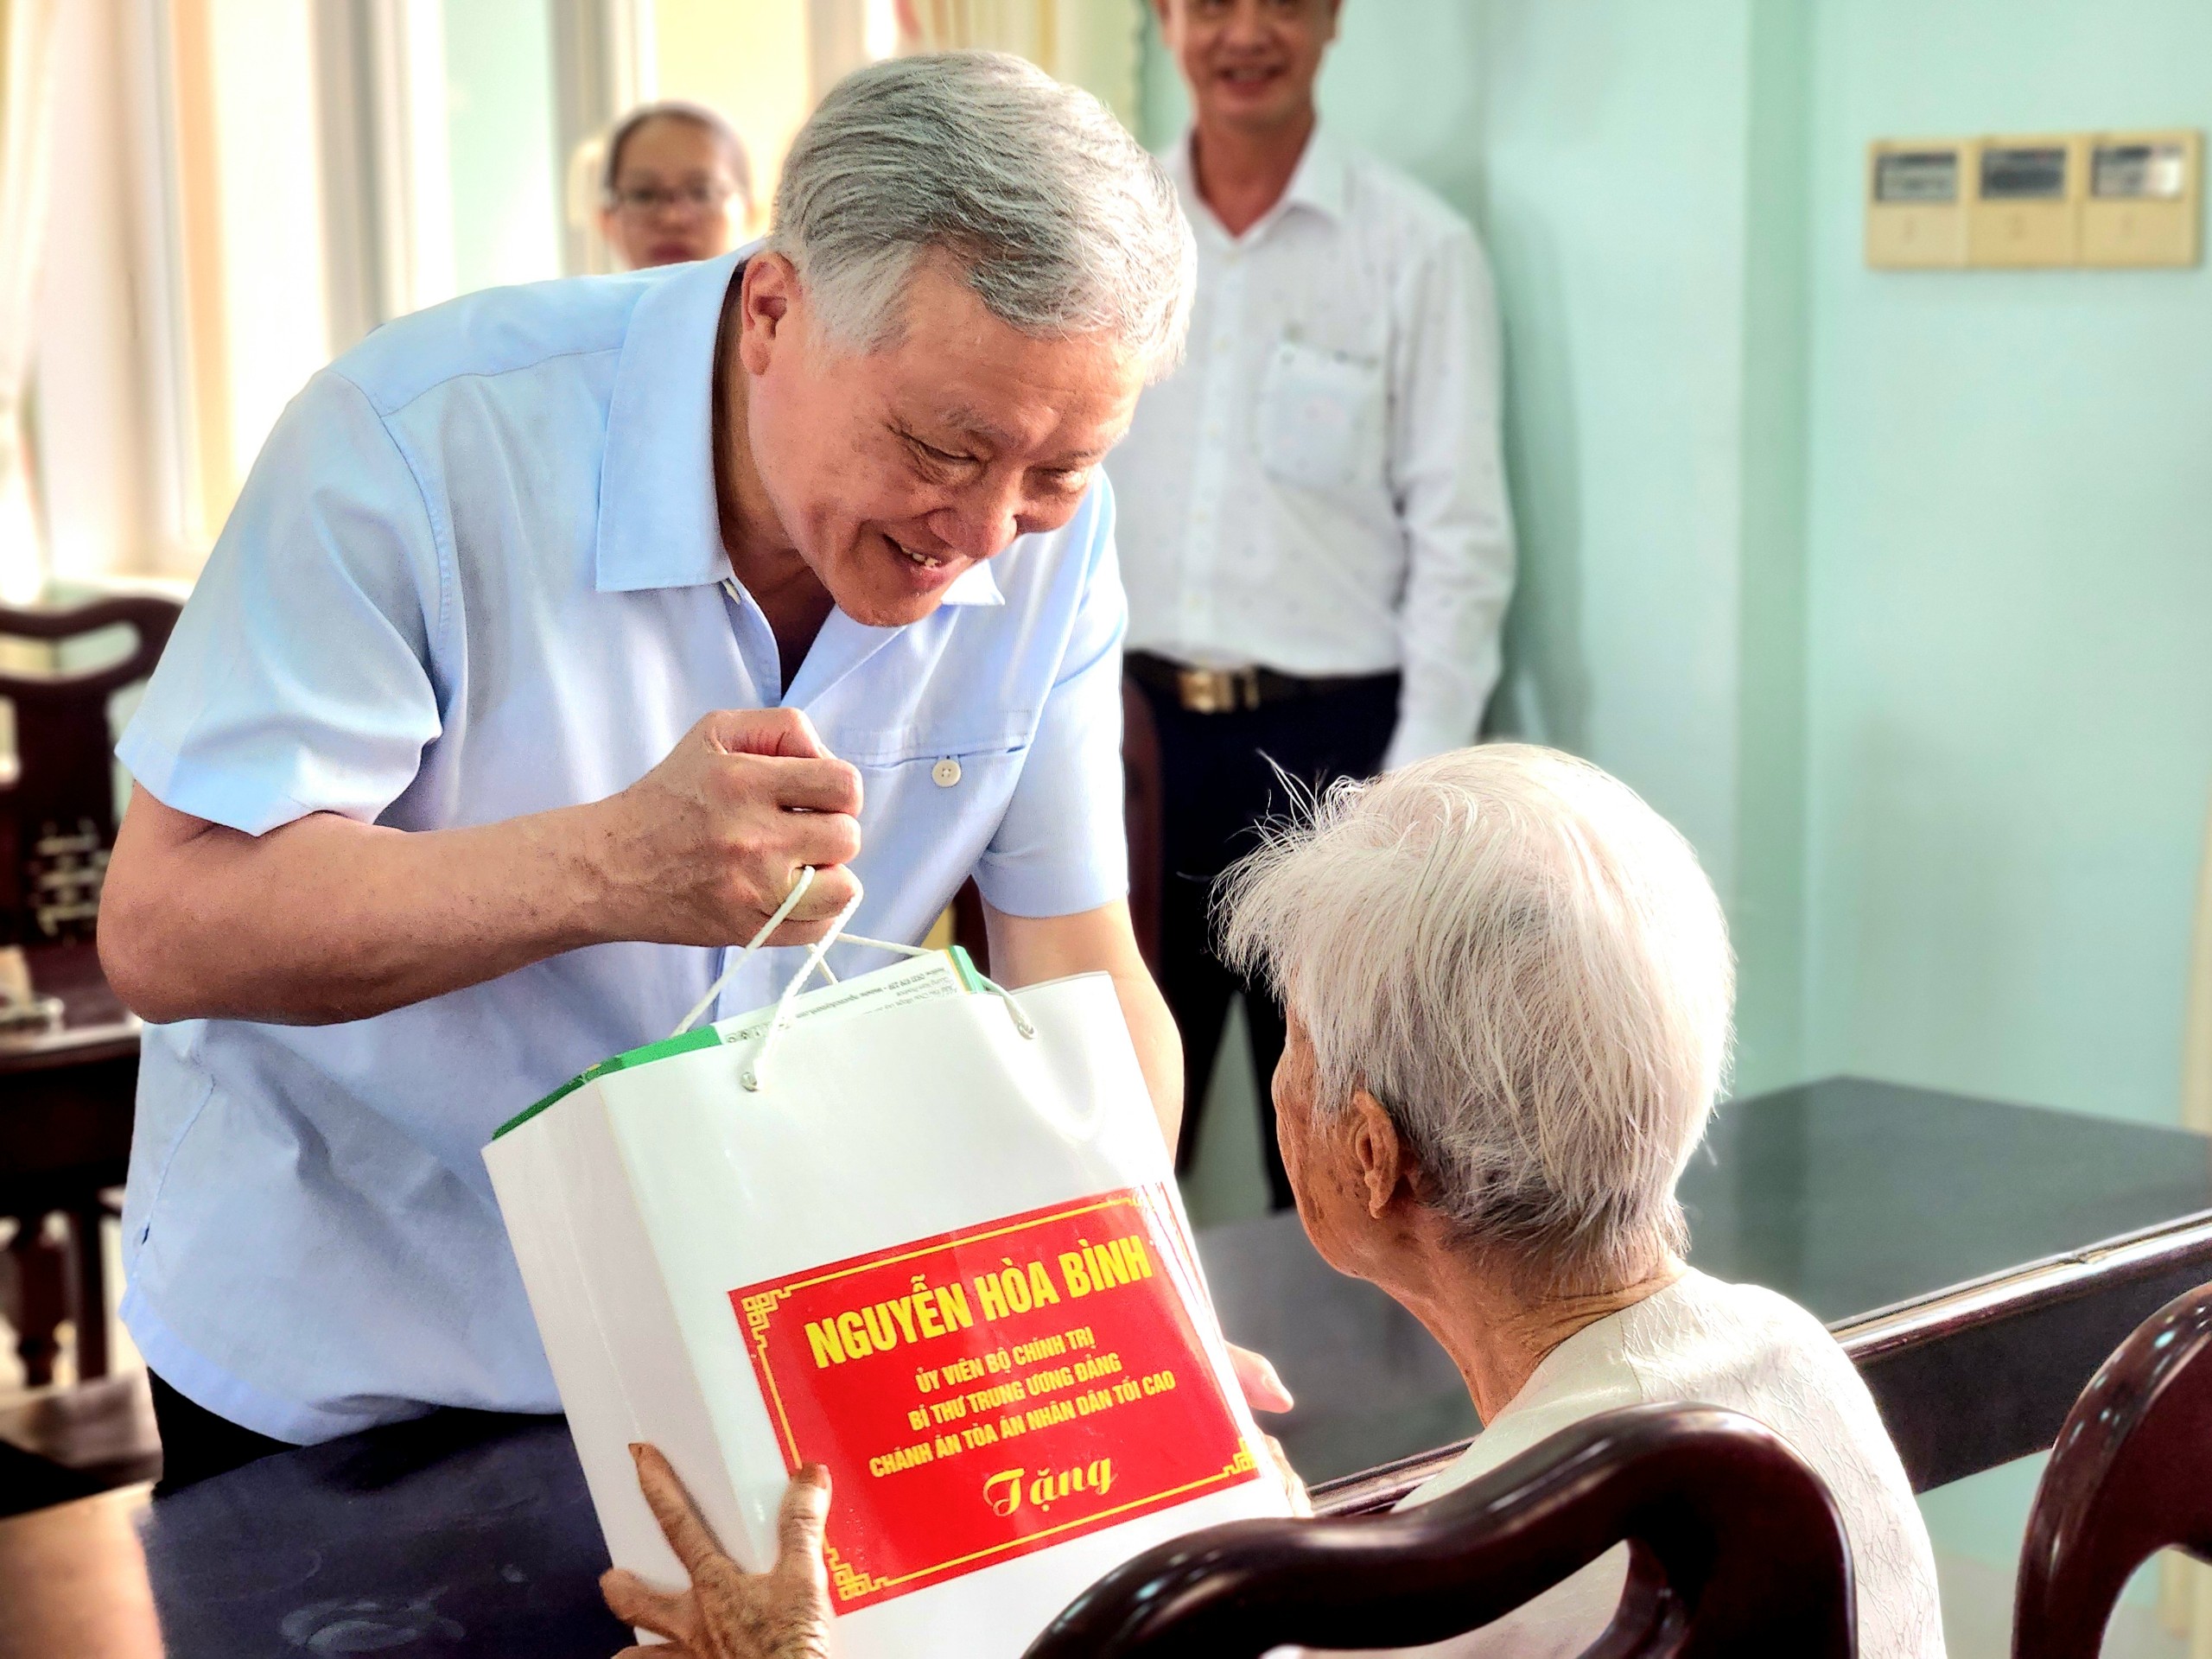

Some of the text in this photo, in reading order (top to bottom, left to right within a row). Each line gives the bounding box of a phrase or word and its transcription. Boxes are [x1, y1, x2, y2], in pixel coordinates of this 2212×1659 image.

[805, 1235, 1154, 1369] NGUYỄN HÒA BÌNH
[908, 1352, 1122, 1431] BÍ THƯ TRUNG ƯƠNG ĐẢNG
[915, 1326, 1096, 1393] ỦY VIÊN BỘ CHÍNH TRỊ
[869, 1370, 1176, 1478] CHÁNH ÁN TÒA ÁN NHÂN DÂN TỐI CAO
[982, 1457, 1116, 1516] Tặng
